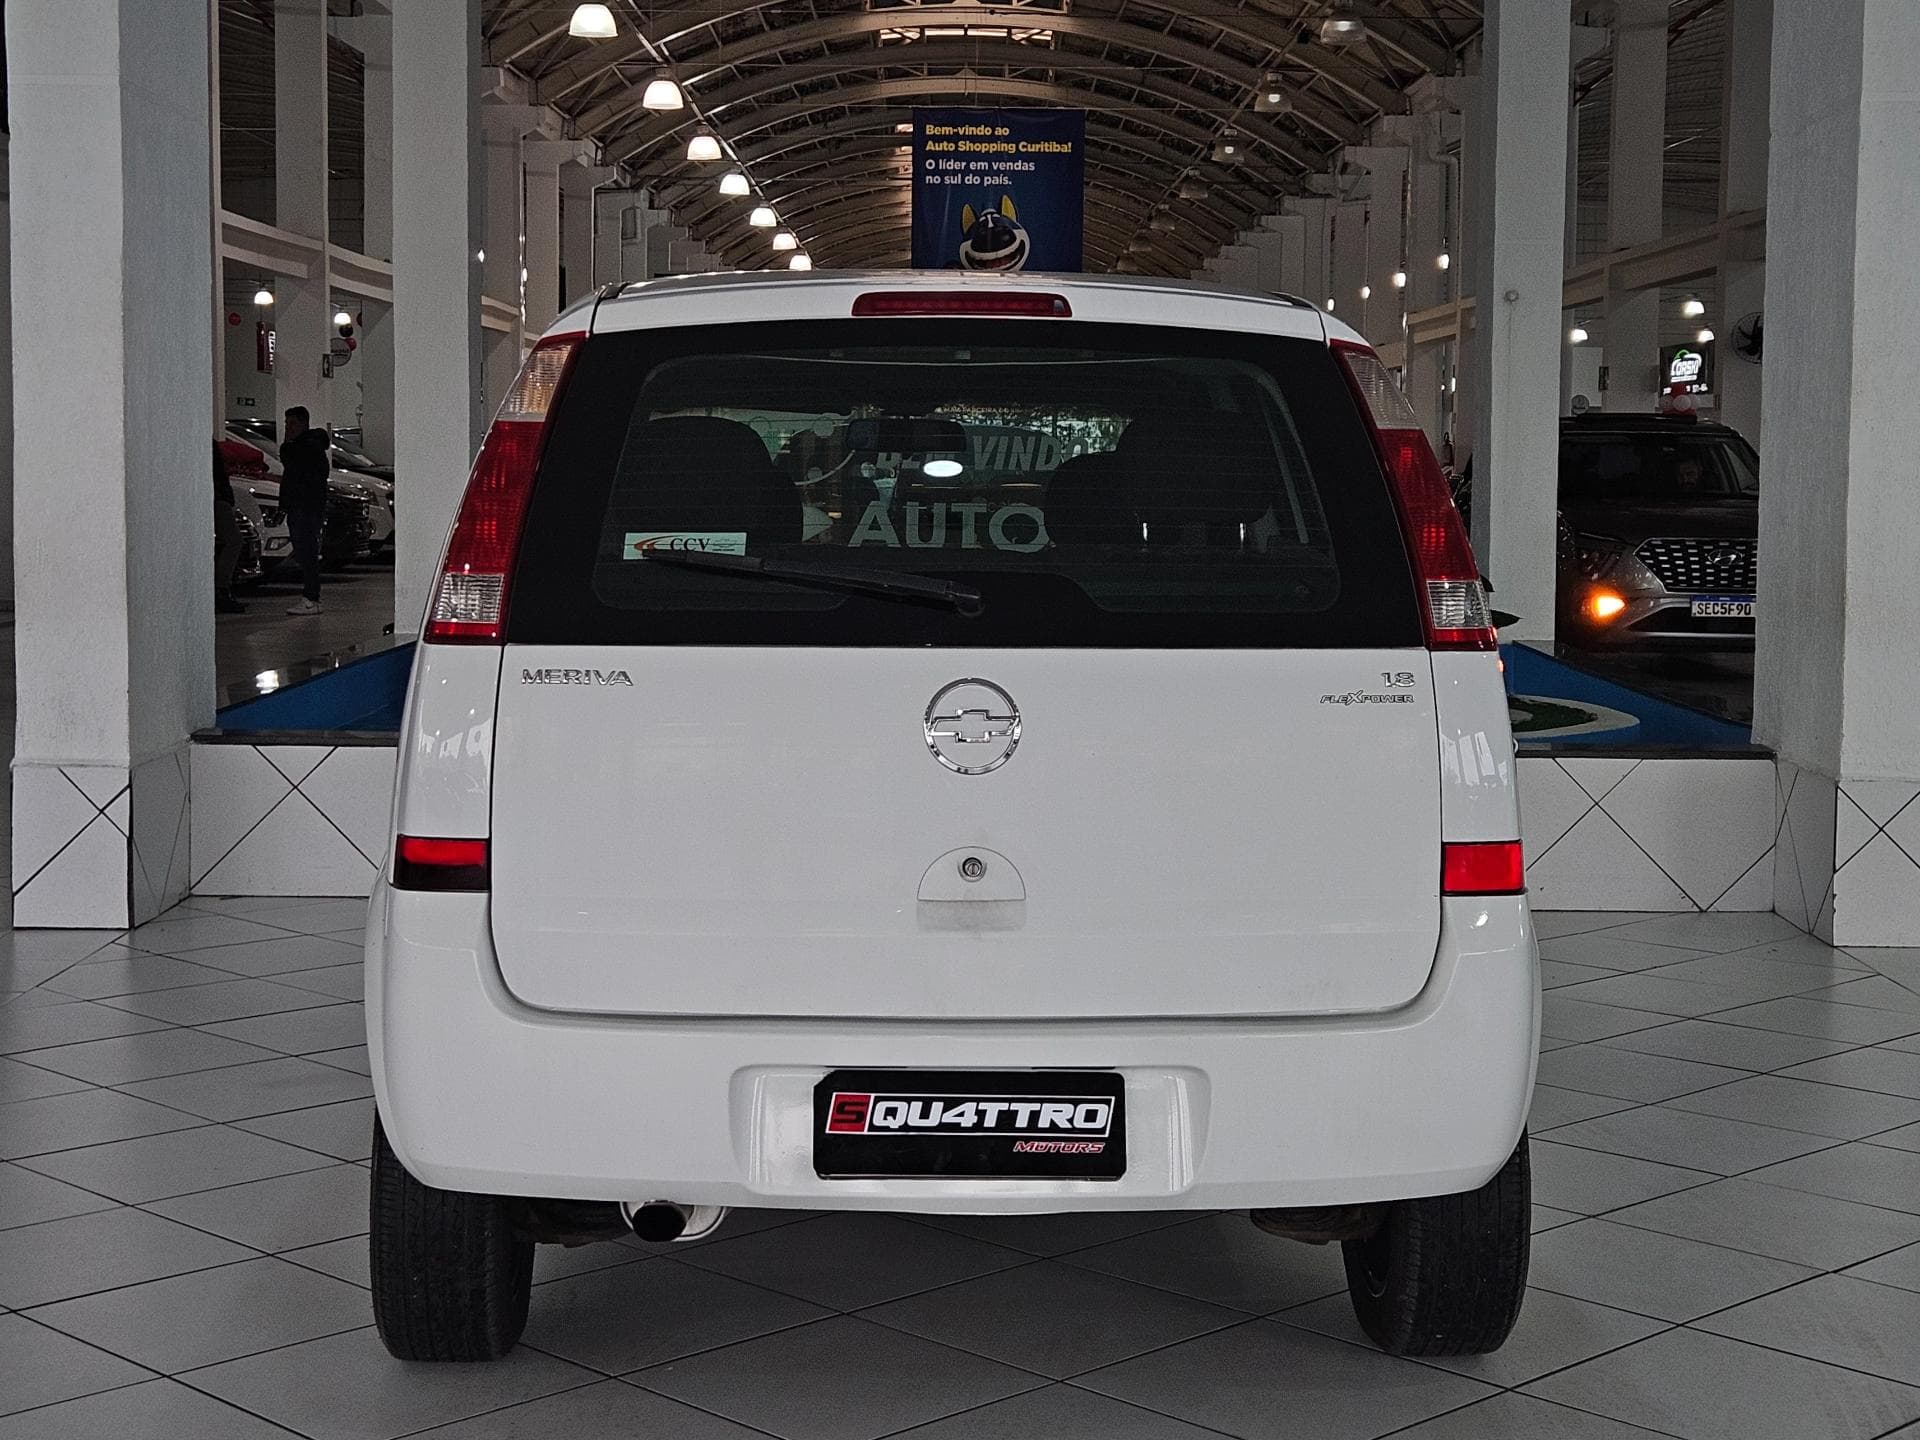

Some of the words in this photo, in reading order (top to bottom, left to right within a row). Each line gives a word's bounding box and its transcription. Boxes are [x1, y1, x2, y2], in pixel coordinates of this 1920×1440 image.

[925, 124, 992, 136] Bem-vindo
[994, 126, 1010, 136] ao
[925, 140, 955, 151] Auto
[957, 140, 1017, 154] Shopping
[1018, 141, 1073, 153] Curitiba!
[925, 159, 936, 170] O
[939, 158, 967, 170] líder
[969, 160, 989, 170] em
[992, 160, 1036, 171] vendas
[925, 174, 941, 184] no
[944, 173, 962, 185] sul
[964, 173, 981, 185] do
[983, 173, 1013, 187] país.
[847, 500, 1051, 553] AUTO
[669, 537, 711, 552] CCV
[1696, 602, 1752, 616] SEC5F90
[521, 668, 634, 687] MERIVA
[1319, 689, 1415, 706] FLEXPOWER
[1012, 1140, 1105, 1154] MOTORS
